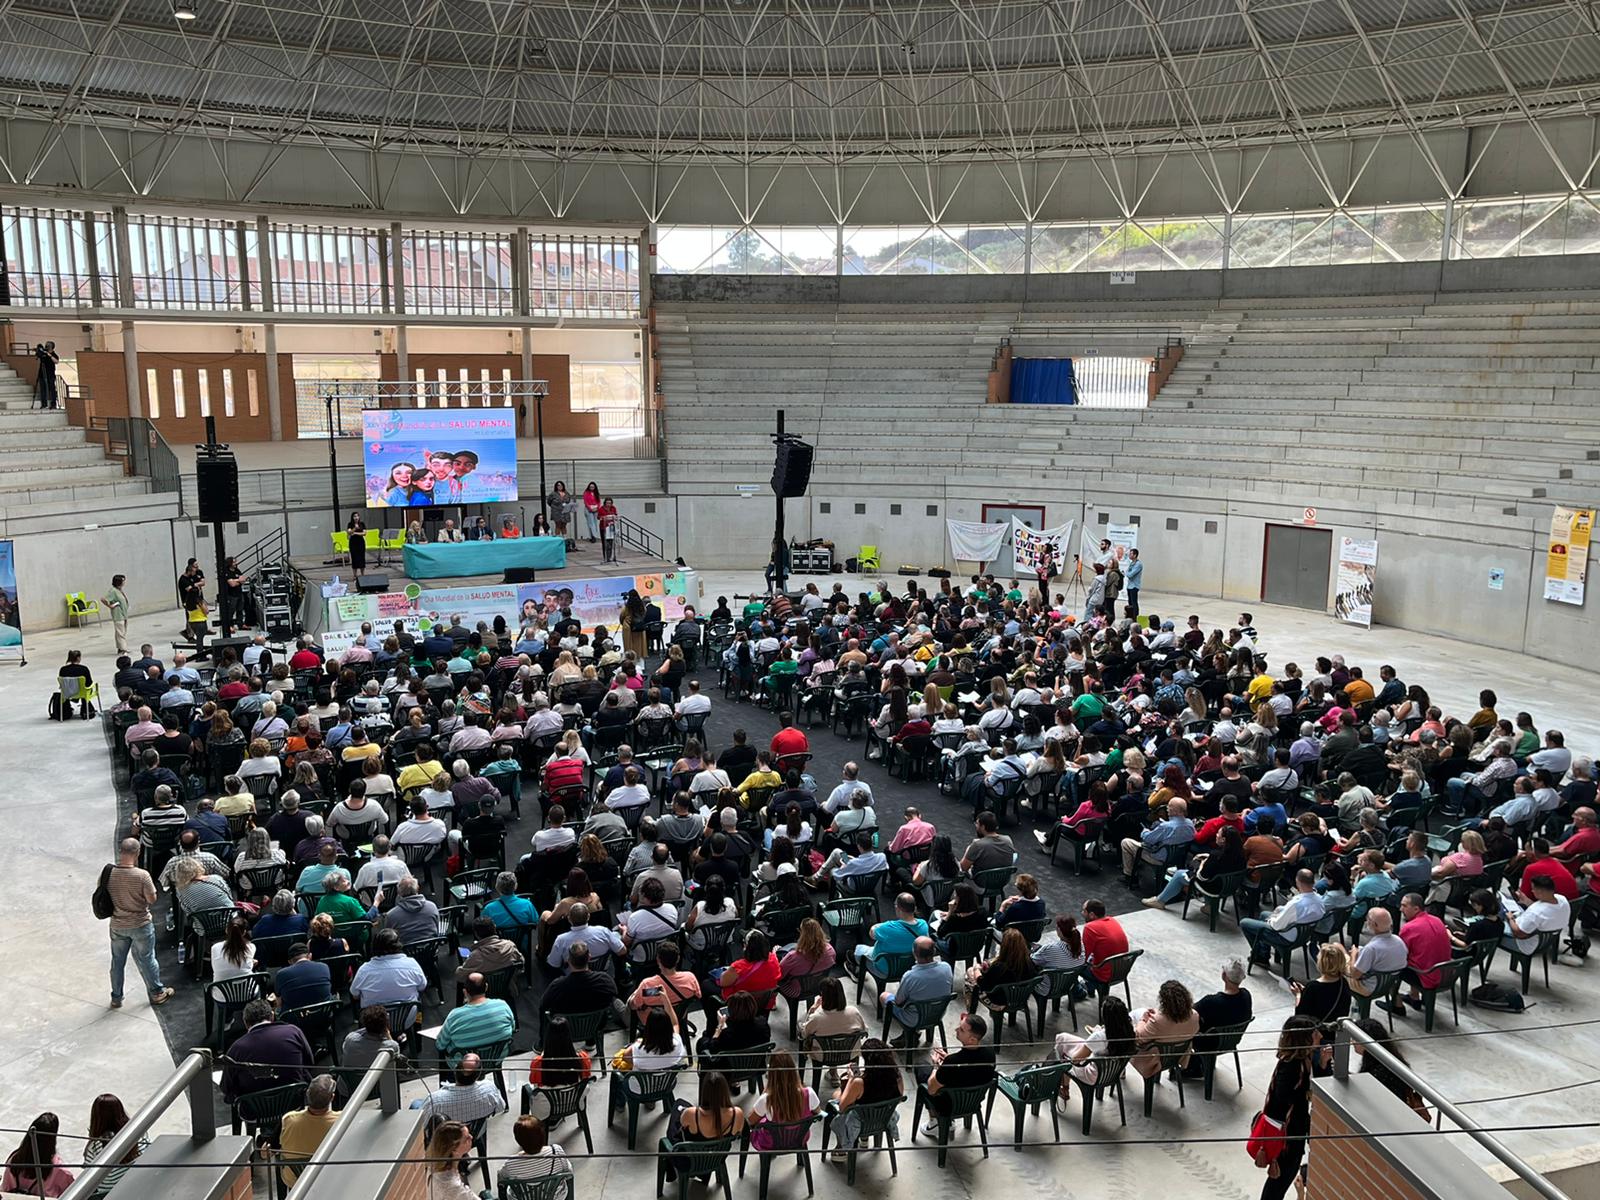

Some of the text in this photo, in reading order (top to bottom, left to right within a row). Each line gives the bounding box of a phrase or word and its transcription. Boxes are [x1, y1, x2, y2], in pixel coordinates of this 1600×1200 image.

[449, 419, 477, 429] SALUD
[479, 419, 512, 428] MENTAL
[1016, 538, 1059, 551] VIVIENS
[435, 594, 456, 602] Mundial
[471, 591, 490, 600] SALUD
[491, 590, 515, 598] MENTAL
